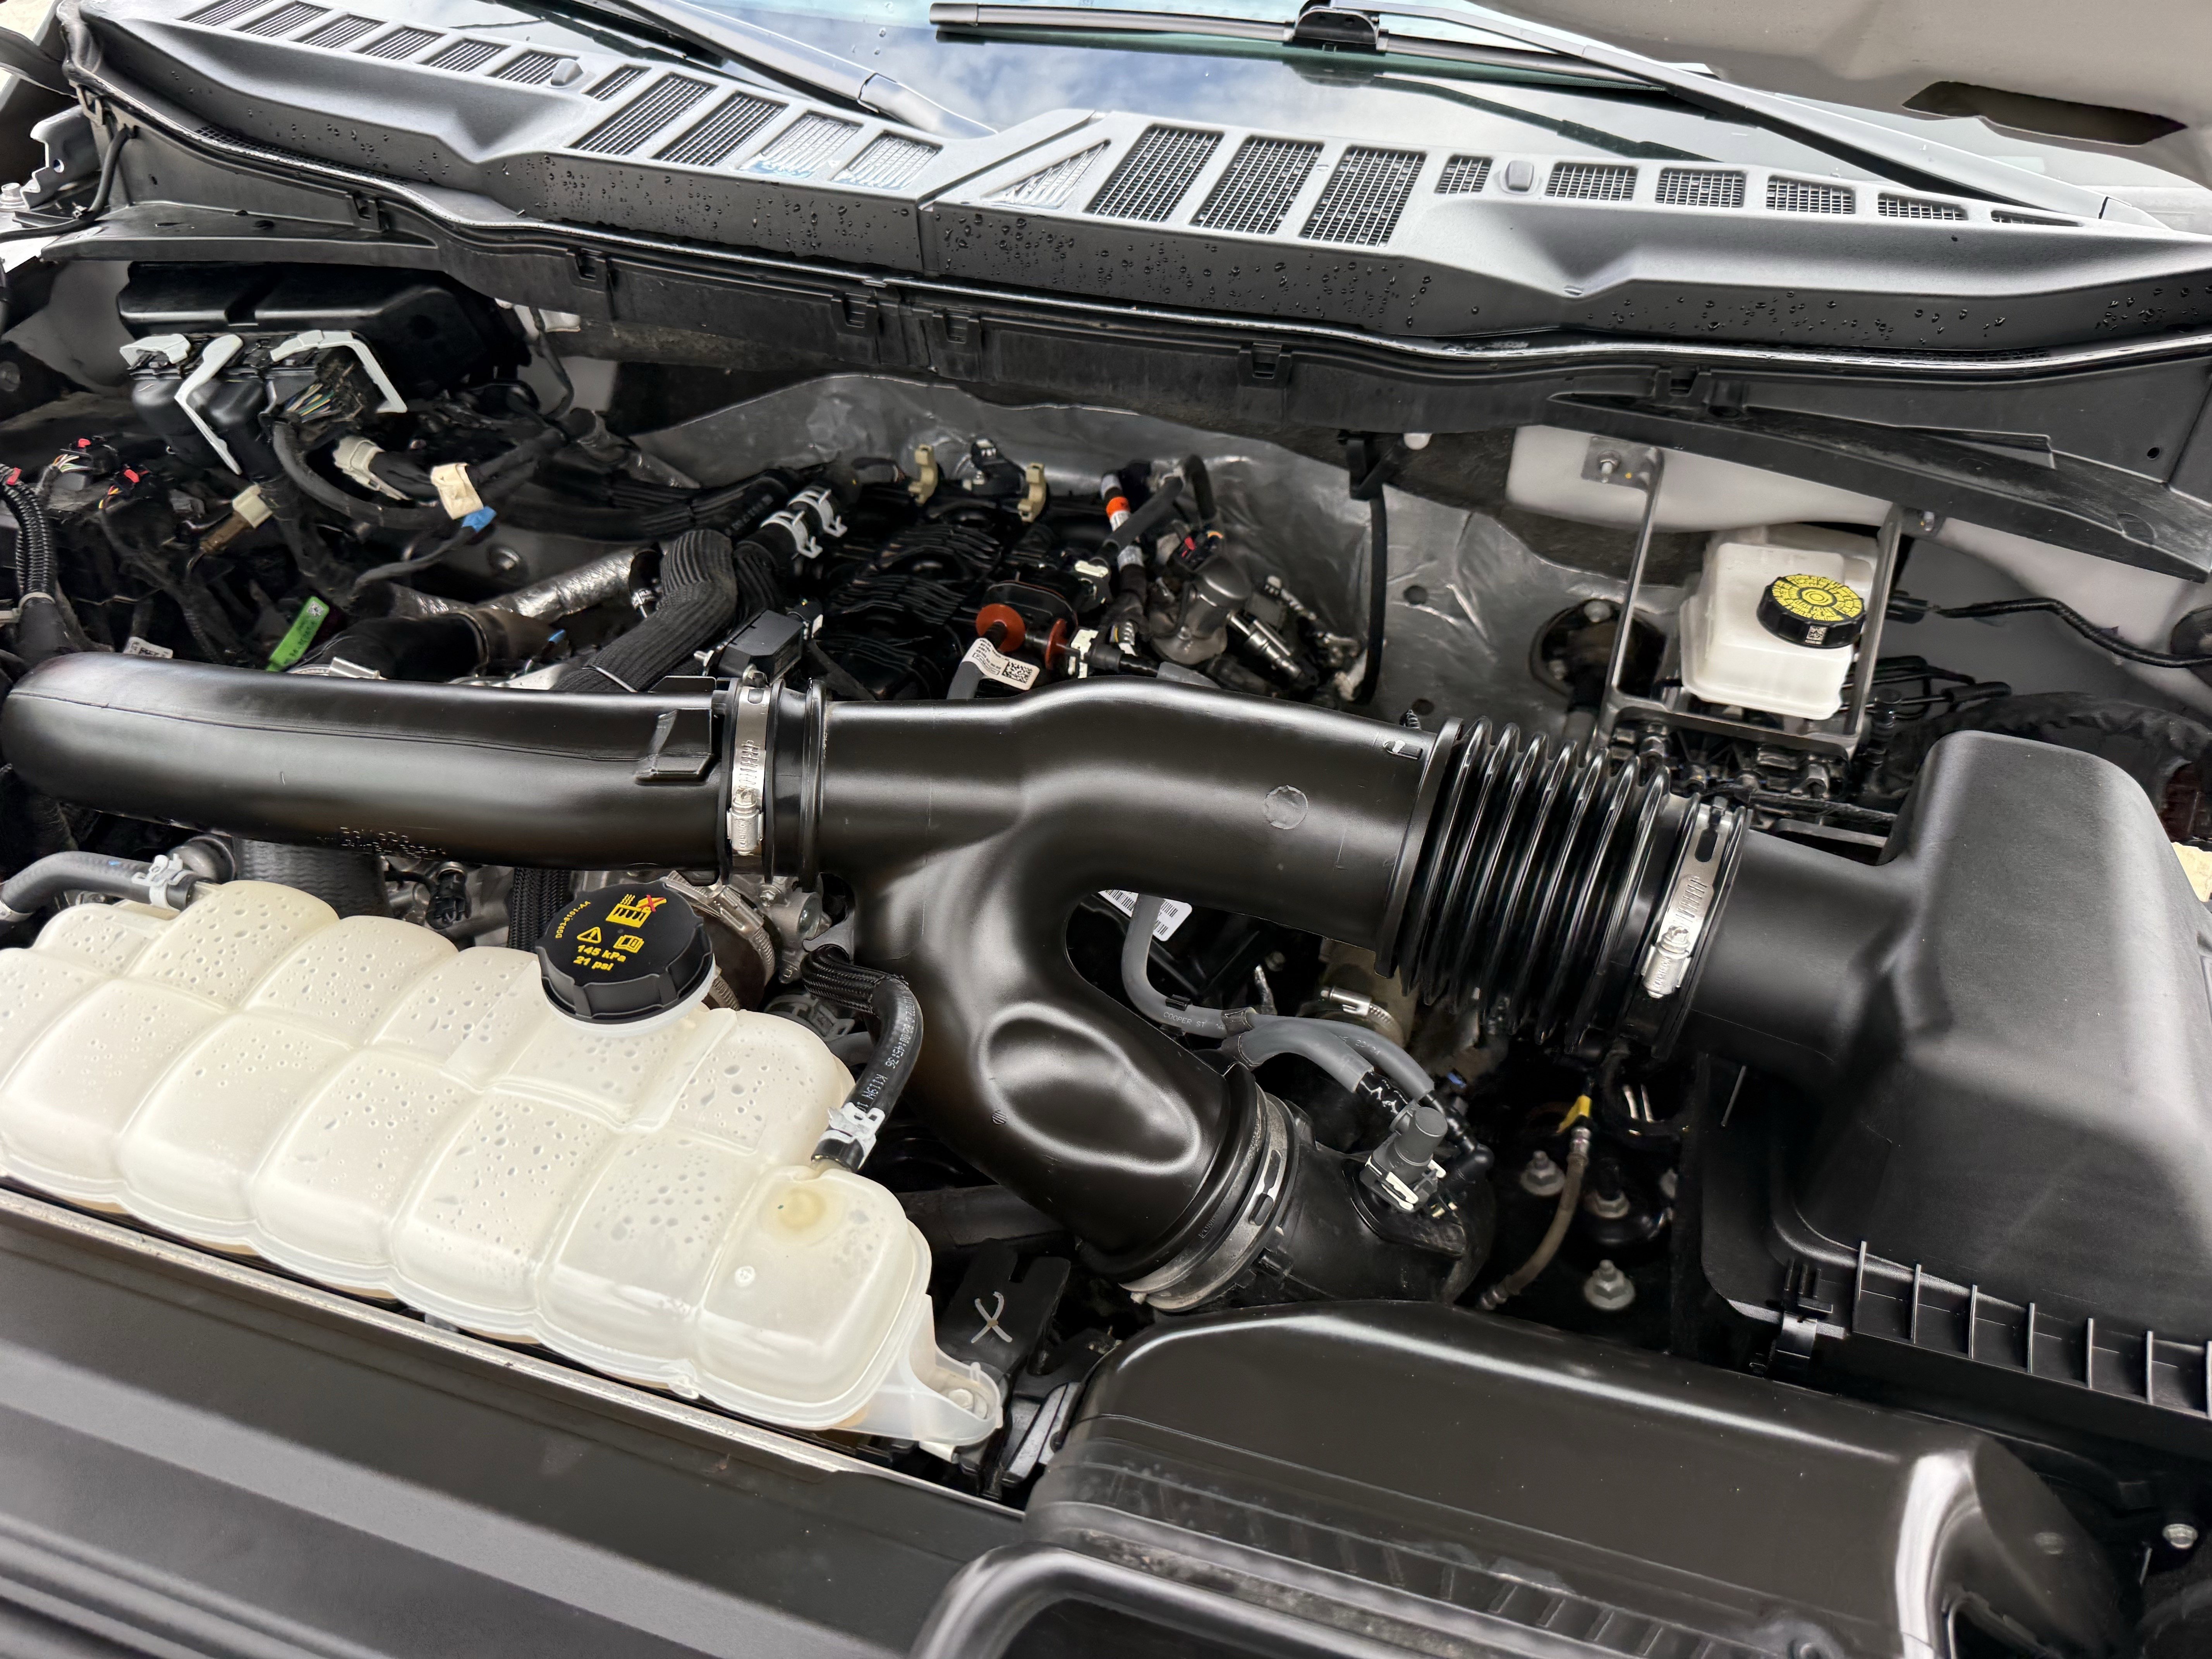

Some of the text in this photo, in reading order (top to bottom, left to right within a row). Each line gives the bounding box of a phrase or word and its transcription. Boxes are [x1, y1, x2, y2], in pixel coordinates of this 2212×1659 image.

[578, 945, 626, 962] 145 kPa
[573, 956, 614, 971] 21 psi
[1163, 1011, 1192, 1025] COOPER
